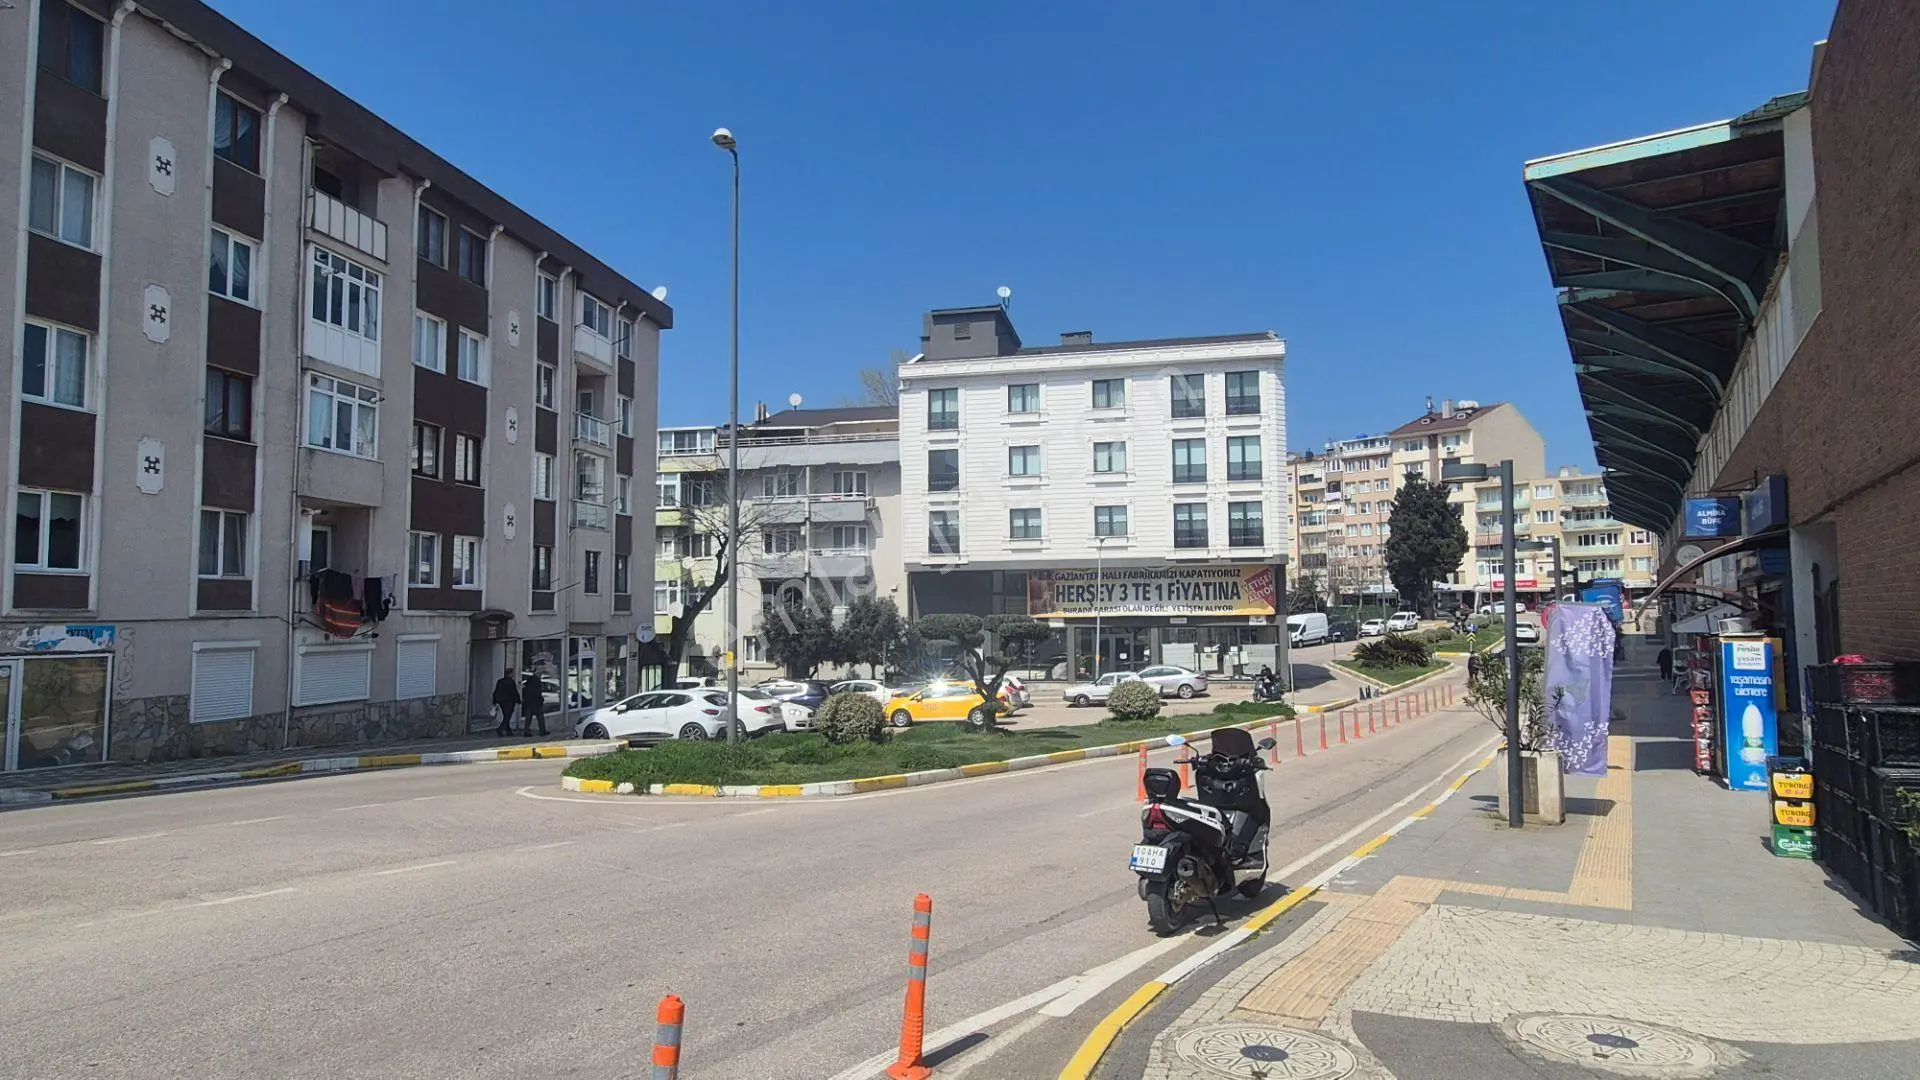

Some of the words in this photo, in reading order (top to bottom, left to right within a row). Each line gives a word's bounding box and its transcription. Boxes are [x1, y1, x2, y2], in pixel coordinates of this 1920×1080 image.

[1102, 570, 1122, 580] HALI
[1180, 568, 1242, 579] KAPATIYORUZ
[1055, 582, 1116, 608] HERŞEY
[1119, 582, 1129, 602] 3
[1132, 582, 1152, 602] TE
[1155, 583, 1163, 602] 1
[1171, 603, 1203, 614] YETİŞEN
[1205, 604, 1233, 612] ALIYOR
[1779, 781, 1810, 790] TUBORG
[1780, 809, 1812, 818] TUBORG
[1778, 838, 1817, 853] Carlsberg
